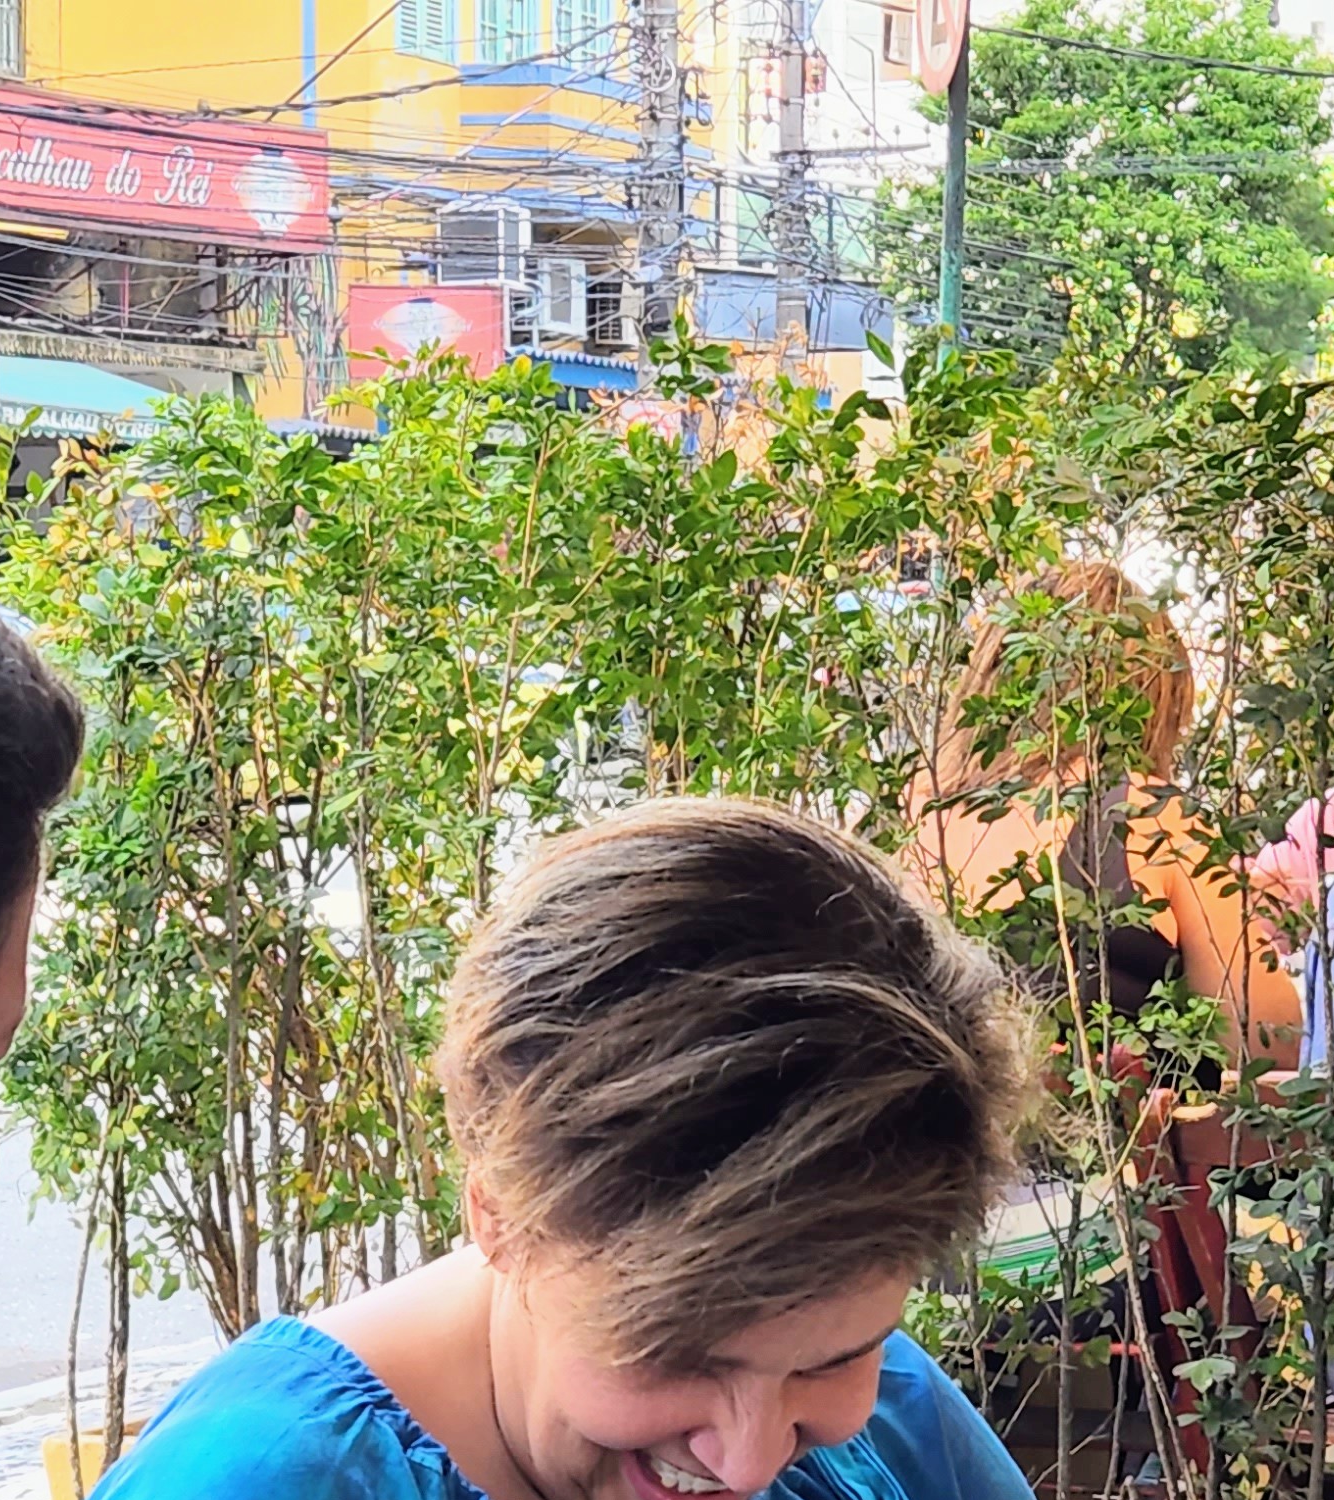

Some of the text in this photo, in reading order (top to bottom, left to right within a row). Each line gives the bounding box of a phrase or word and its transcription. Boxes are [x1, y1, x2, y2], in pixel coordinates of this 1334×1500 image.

[105, 147, 142, 196] do
[154, 145, 214, 206] Rei
[1, 406, 101, 433] BAALHAU
